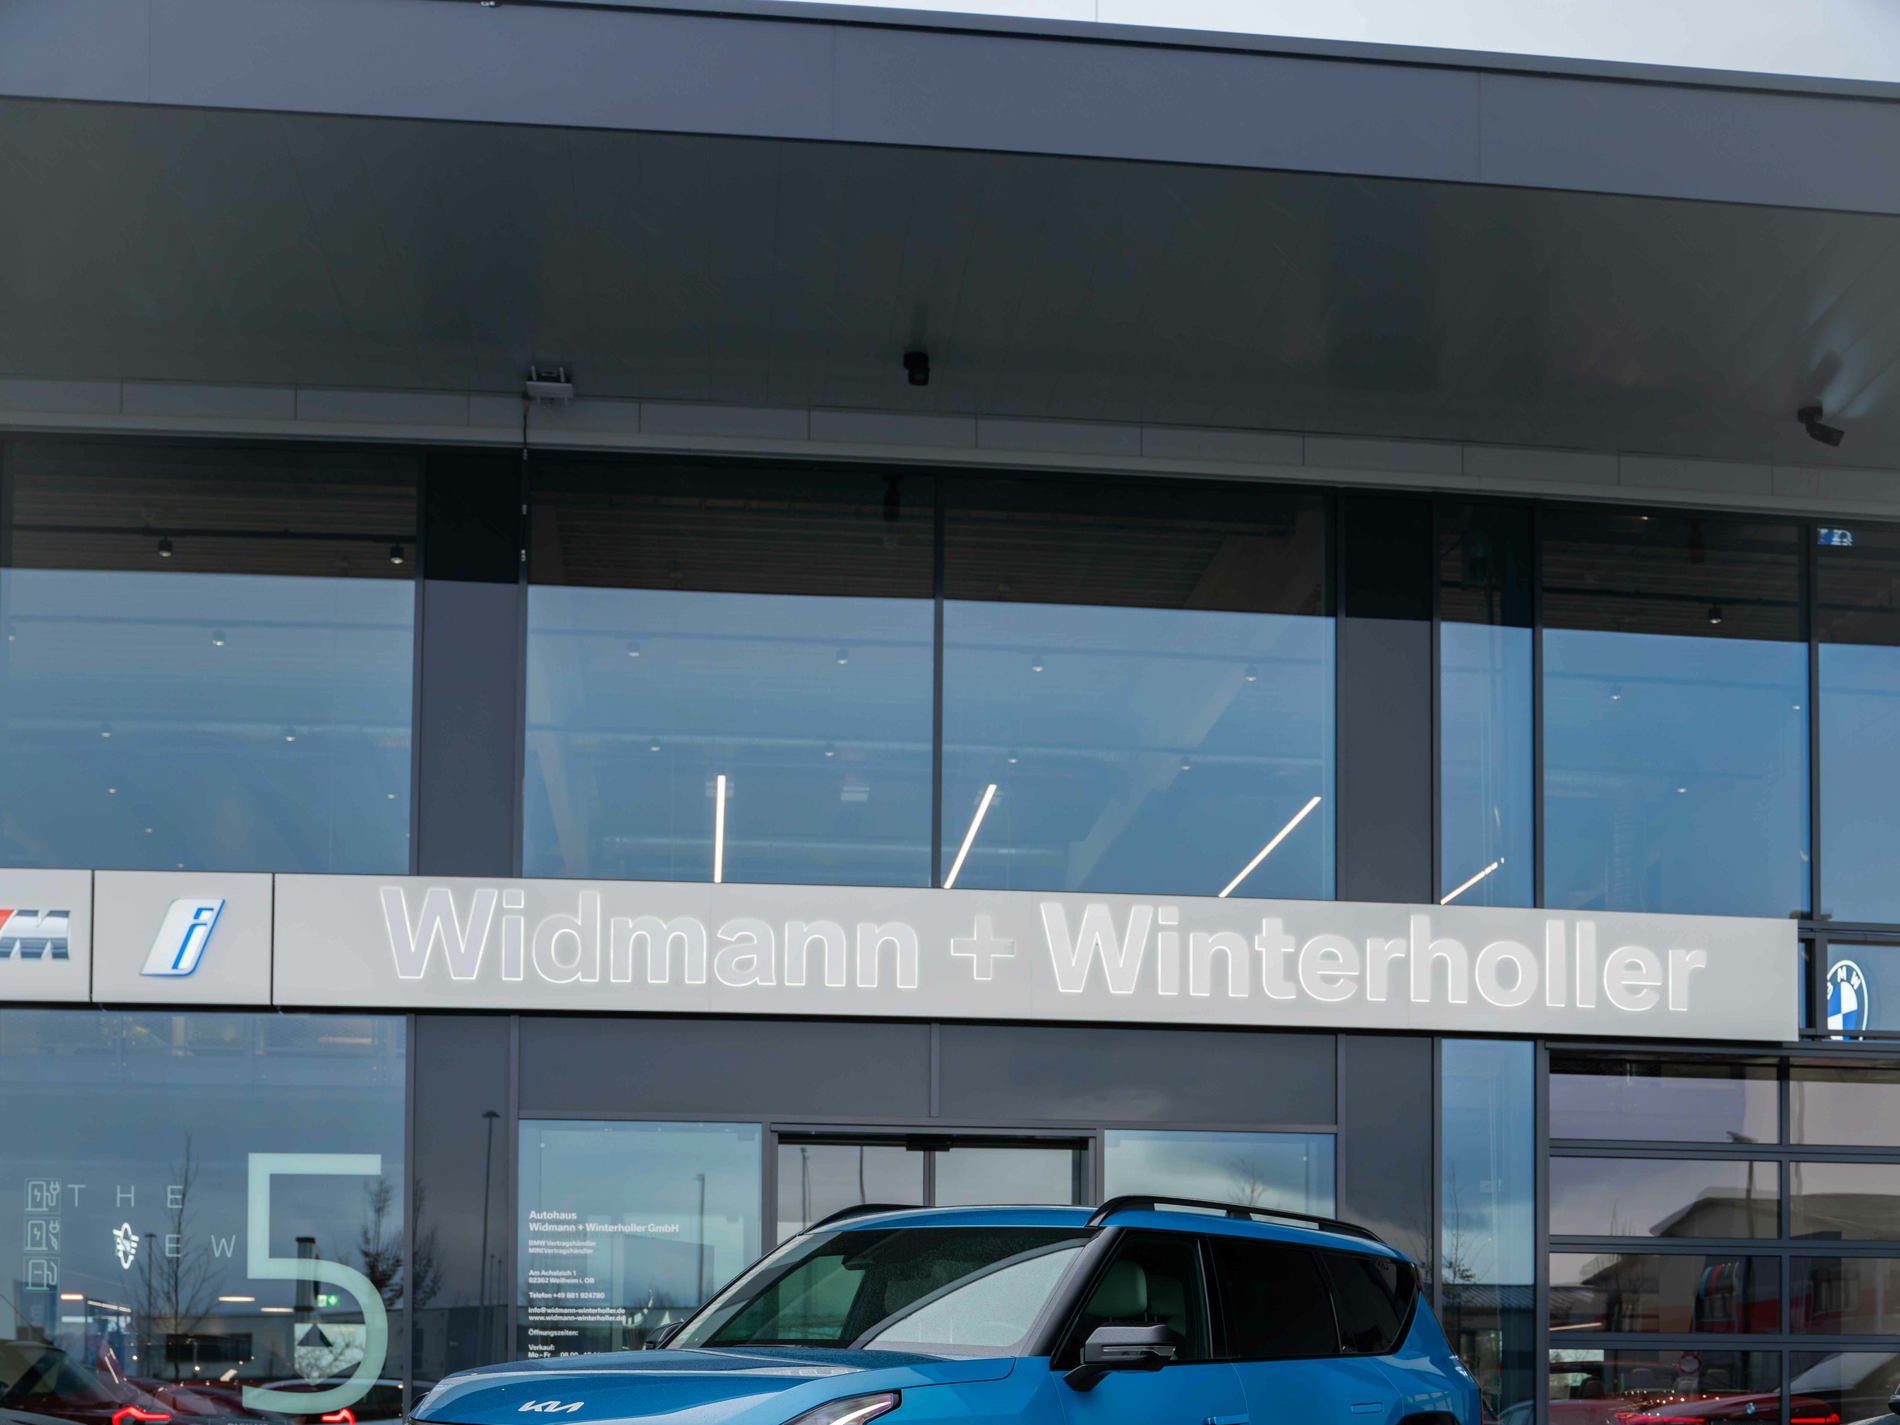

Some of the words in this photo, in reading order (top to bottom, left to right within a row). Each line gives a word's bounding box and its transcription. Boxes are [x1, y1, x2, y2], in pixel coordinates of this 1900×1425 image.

[379, 886, 918, 990] Widmann
[1040, 901, 1707, 1011] Winterholler
[67, 1184, 184, 1209] THE
[529, 1210, 577, 1220] Autohaus
[529, 1223, 576, 1232] Widmann
[585, 1223, 647, 1232] Winterholler
[648, 1223, 680, 1233] GmbH
[242, 1152, 389, 1415] 5
[518, 1400, 585, 1413] KIA
